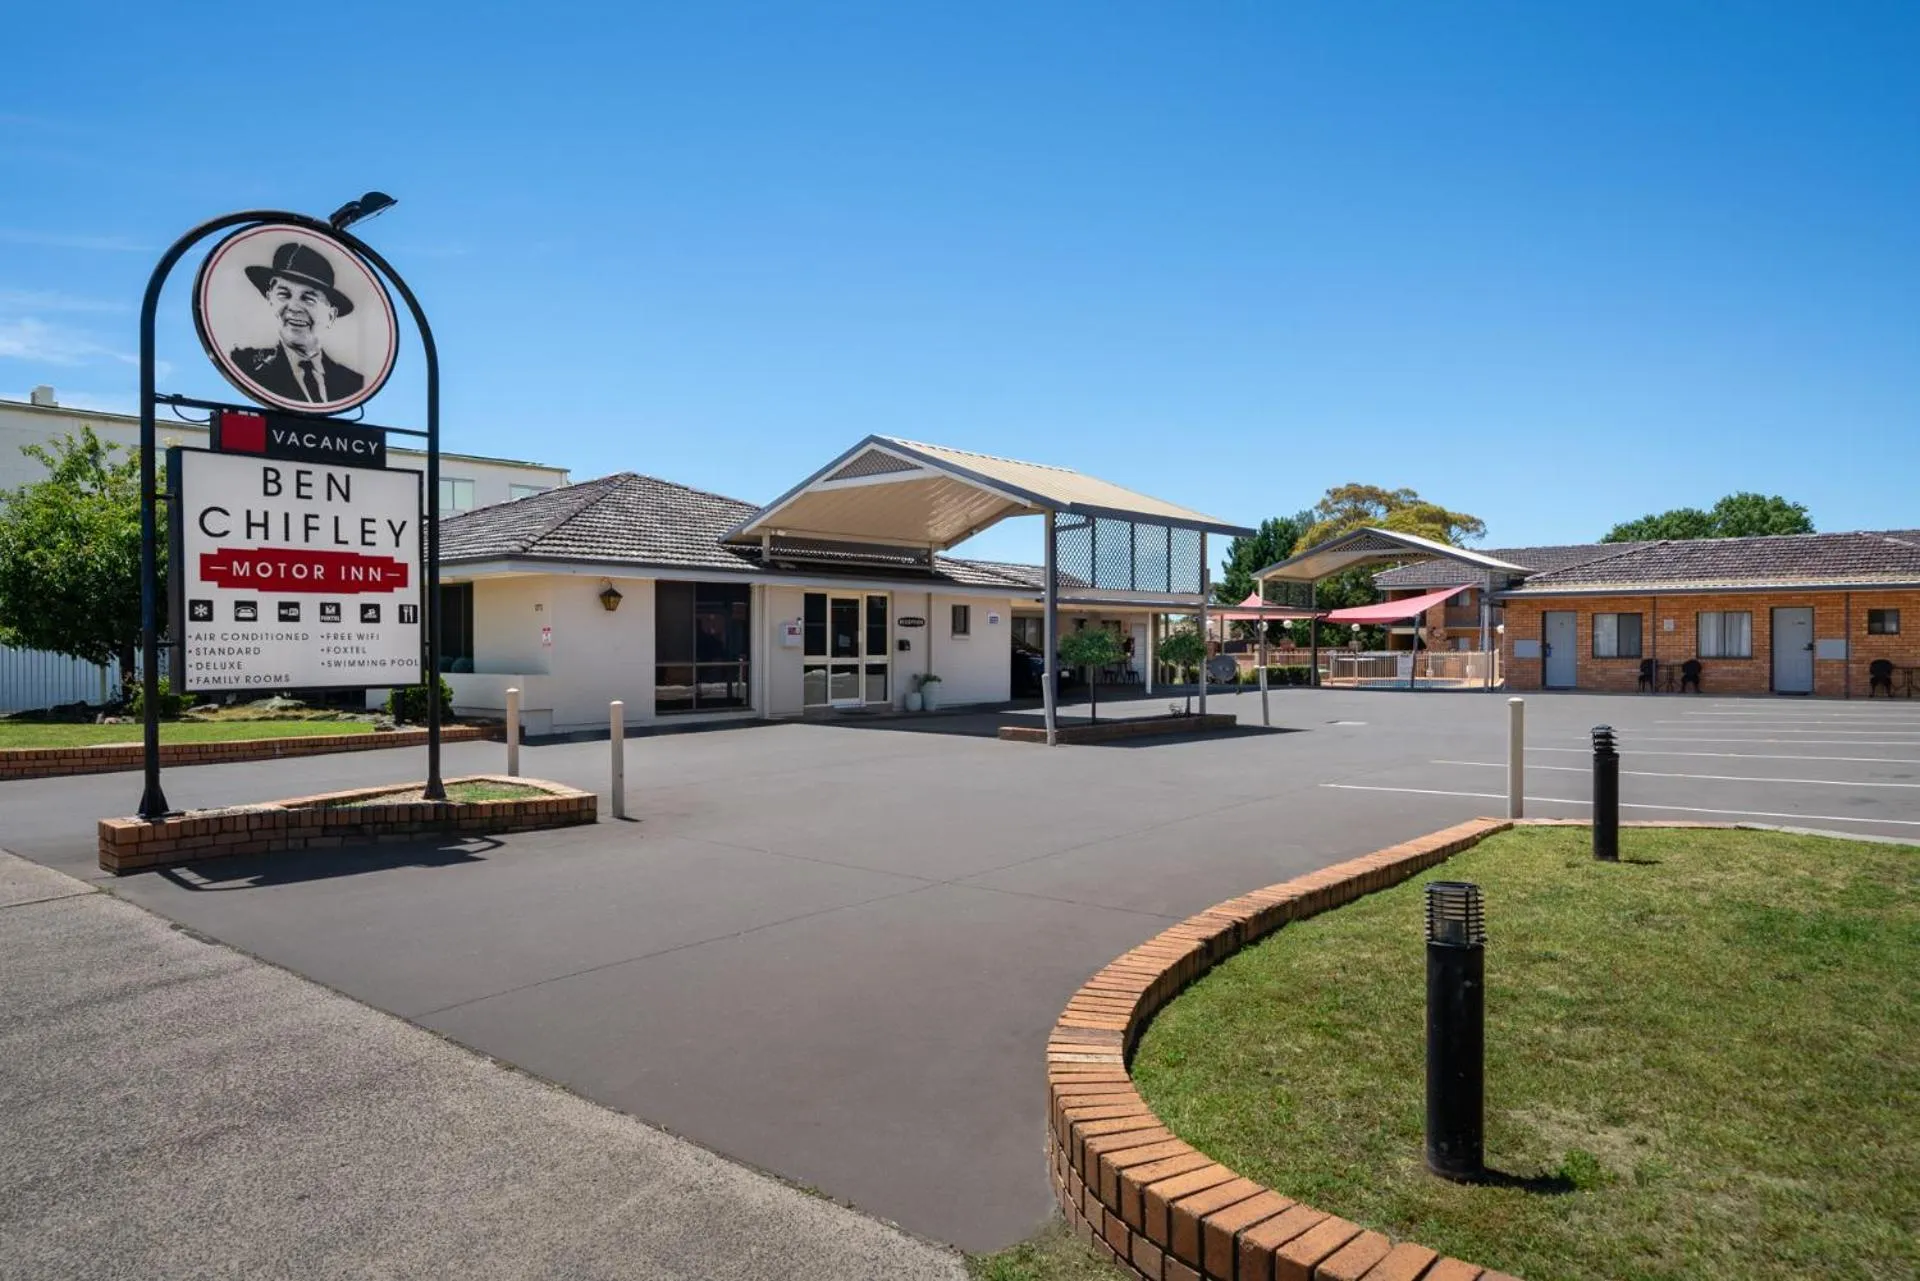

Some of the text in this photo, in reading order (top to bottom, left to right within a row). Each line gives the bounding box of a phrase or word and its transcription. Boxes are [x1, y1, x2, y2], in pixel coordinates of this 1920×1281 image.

[272, 430, 379, 455] VACANCY
[263, 467, 351, 503] BEN
[198, 506, 408, 548] CHIFLEY
[232, 560, 382, 582] MOTOR INN
[195, 632, 310, 642] AIR CONDITIONED
[327, 632, 380, 641] FREE WIFI
[195, 646, 261, 656] STANDARD
[327, 646, 367, 655] FOXTEL
[195, 661, 244, 670] DELUXE
[327, 658, 419, 668] SWIMMING POOL
[196, 674, 291, 685] FAMILY ROOMS
